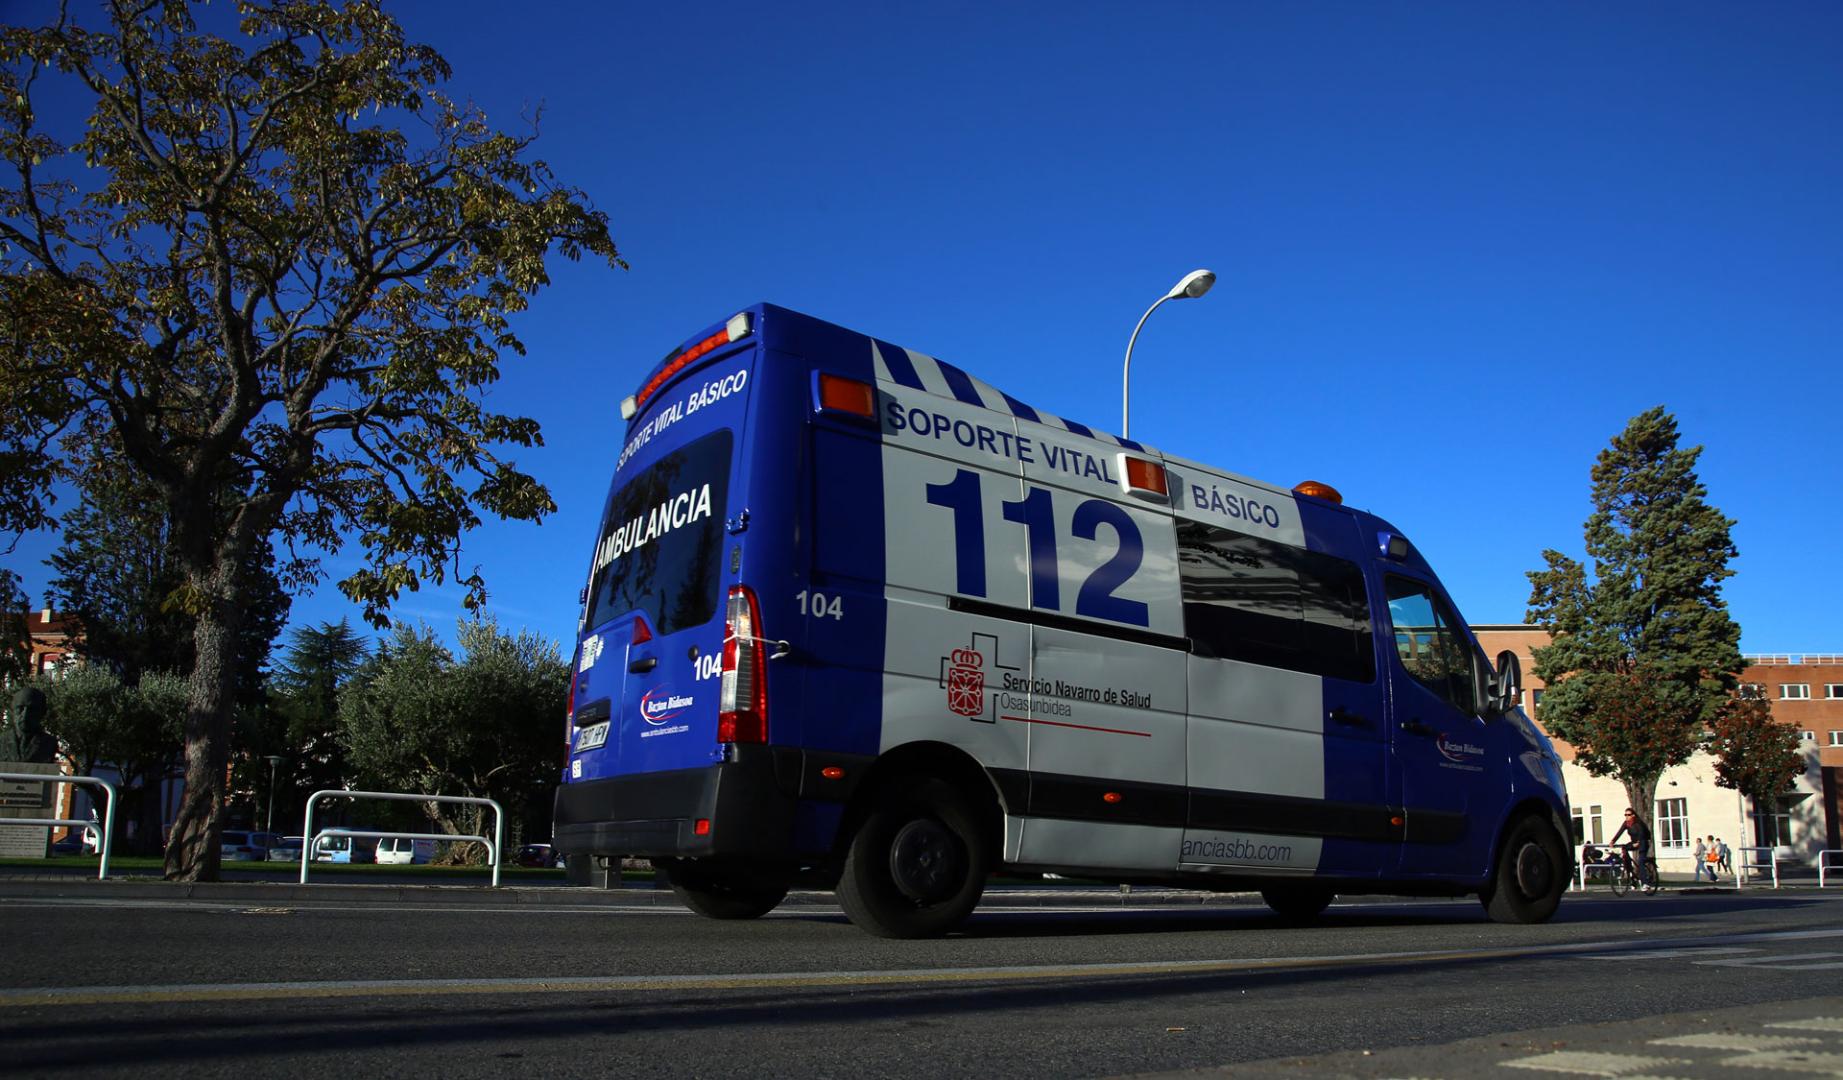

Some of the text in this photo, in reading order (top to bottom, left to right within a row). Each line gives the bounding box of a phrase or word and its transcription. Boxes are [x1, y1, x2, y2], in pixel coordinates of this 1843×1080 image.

[616, 370, 747, 472] SOPORTE VITAL BÁSICO
[886, 402, 1280, 529] SOPORTE VITAL BÁSICO
[595, 483, 711, 574] AMBULANCIA
[926, 468, 1149, 627] 112
[796, 590, 843, 620] 104
[694, 652, 722, 681] 104
[1001, 693, 1071, 717] Osasunbidea
[1003, 672, 1151, 708] Servicio Navarro de Salud
[1183, 837, 1291, 861] anciasbb.com
